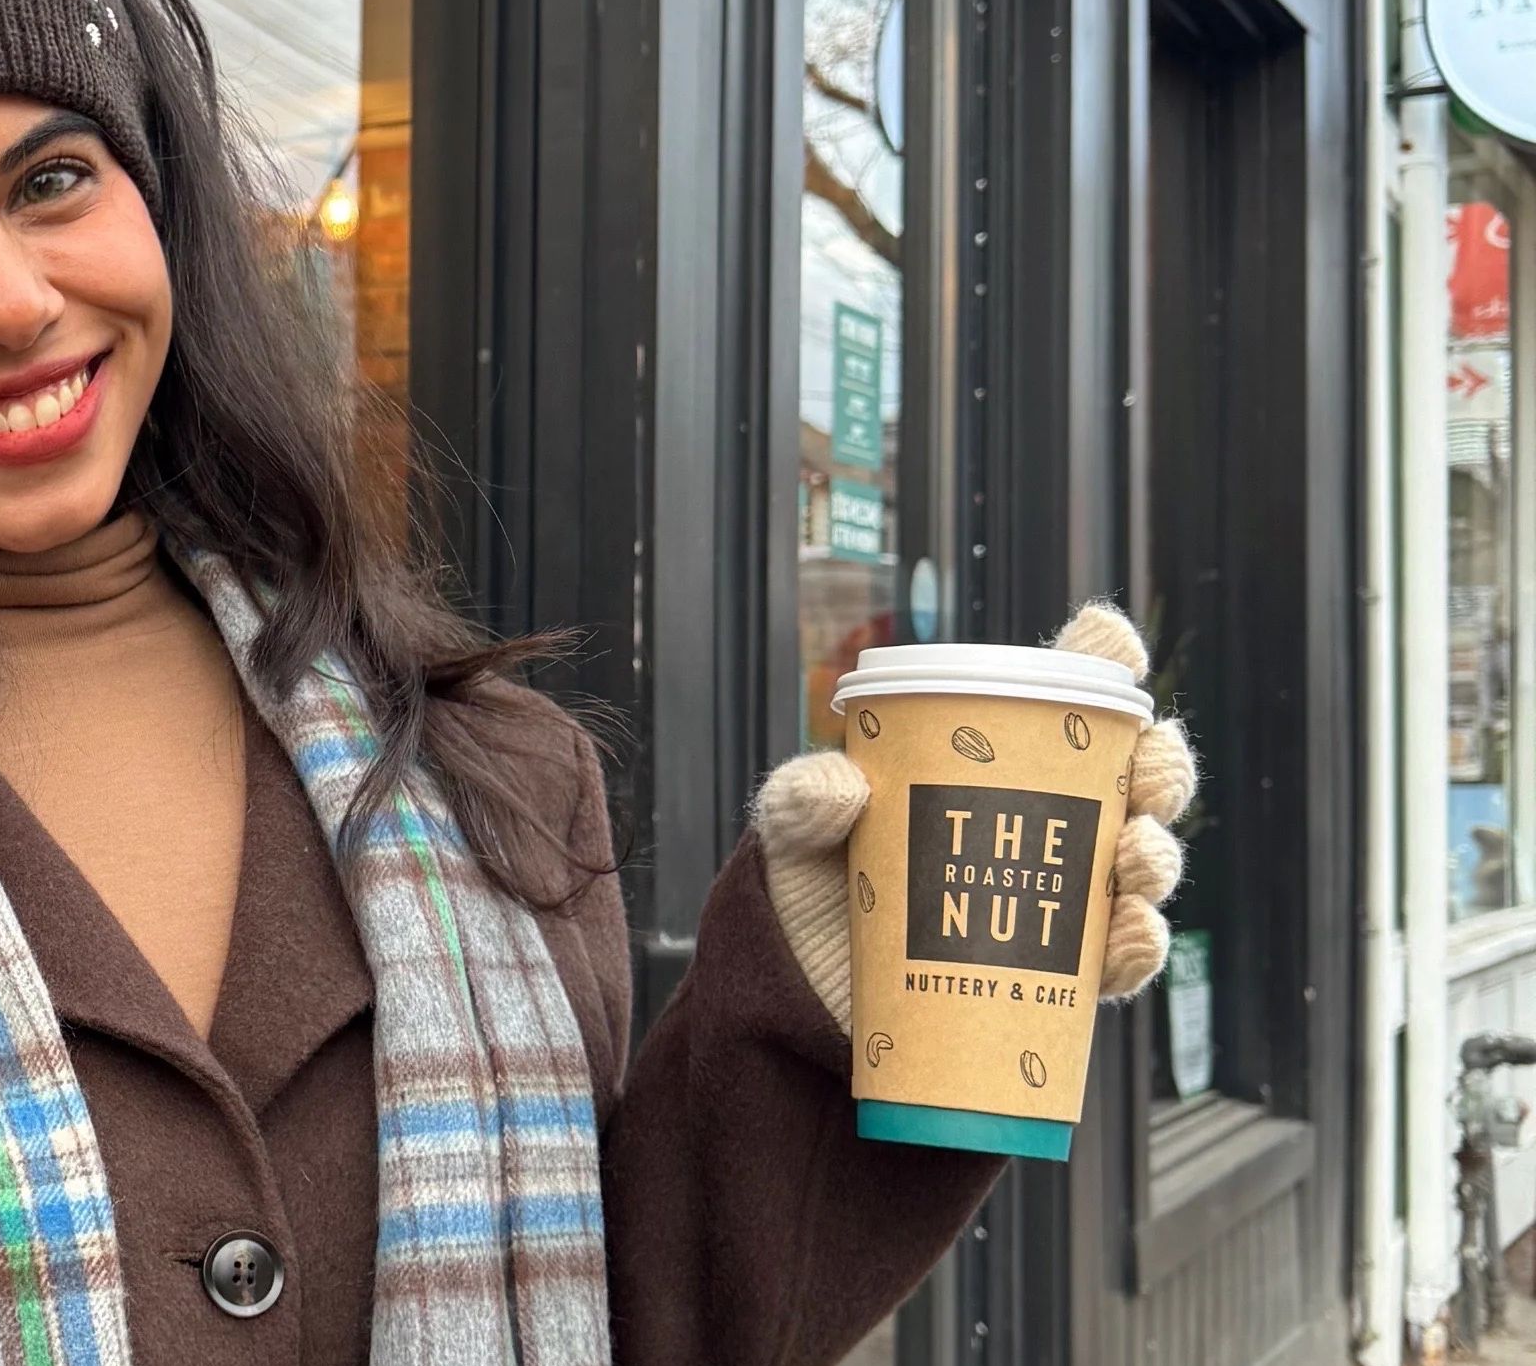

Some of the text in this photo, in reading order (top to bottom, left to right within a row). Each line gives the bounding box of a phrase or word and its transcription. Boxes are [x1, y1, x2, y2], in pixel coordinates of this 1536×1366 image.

[945, 809, 1067, 865] THE
[945, 863, 1062, 893] ROASTED
[942, 891, 1060, 946] NUT
[905, 972, 1077, 1008] NUTTERY & CAFÉ
